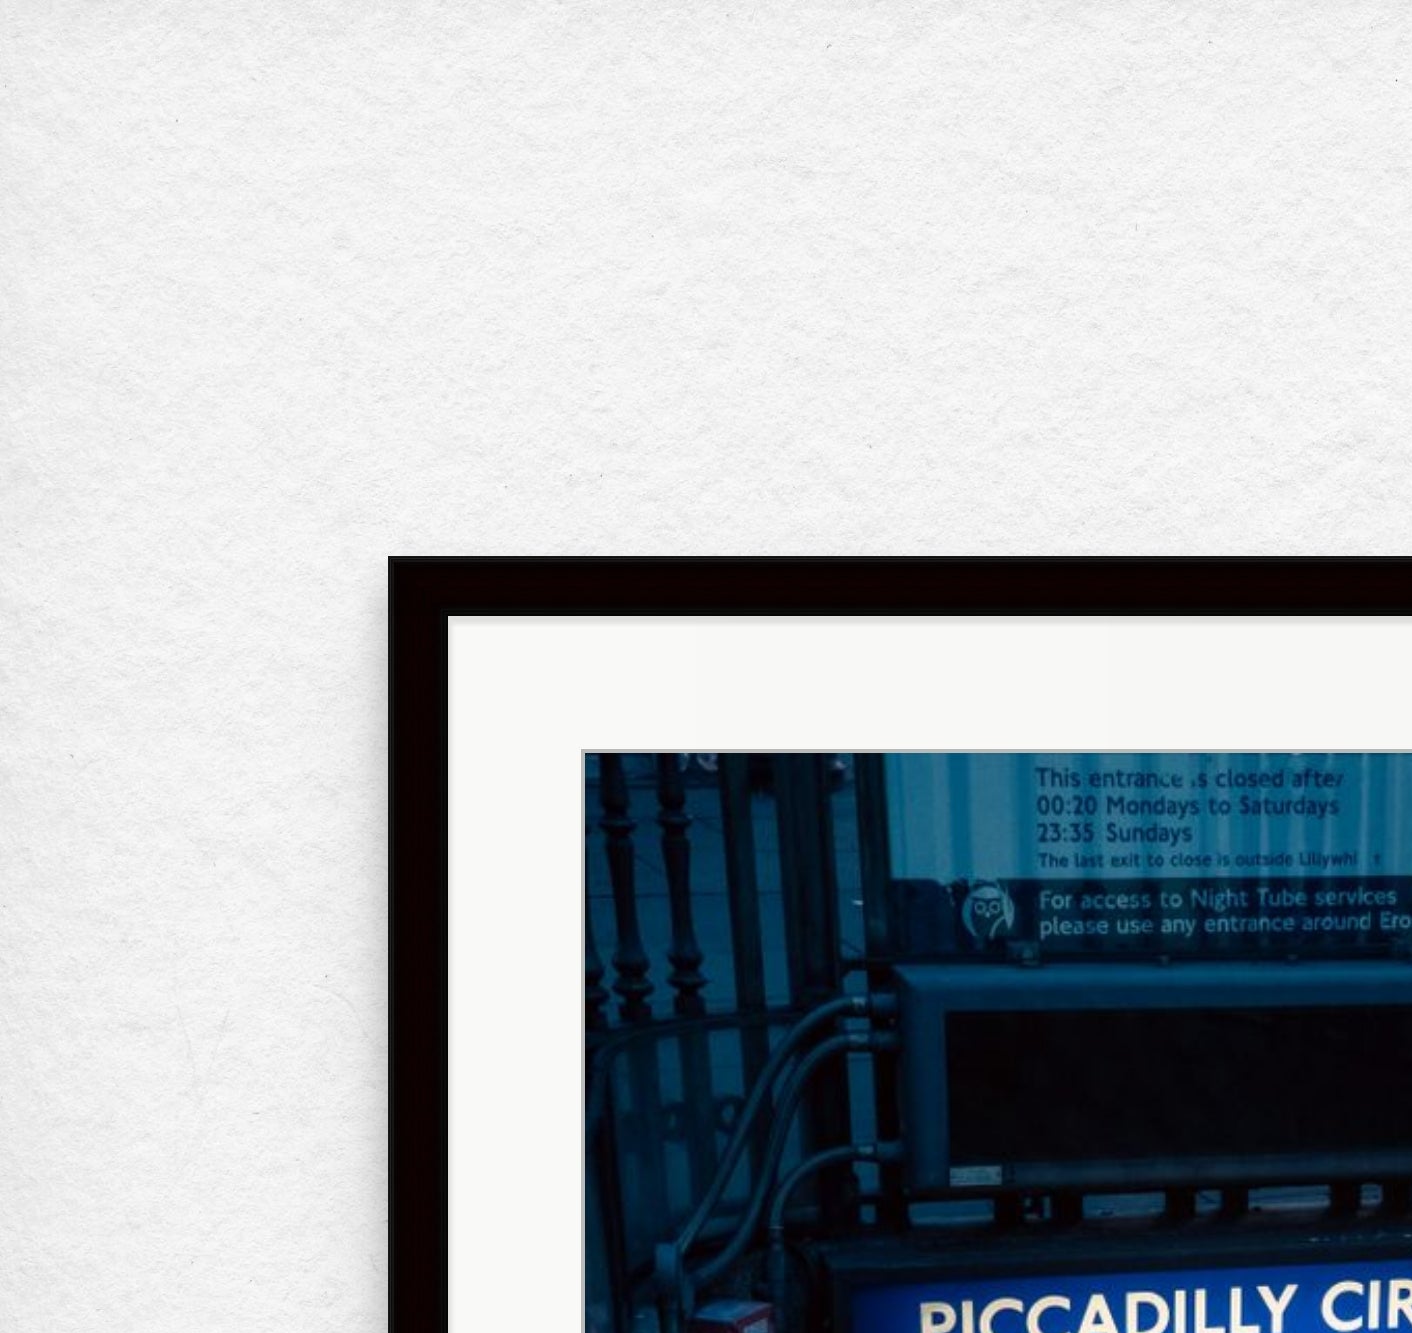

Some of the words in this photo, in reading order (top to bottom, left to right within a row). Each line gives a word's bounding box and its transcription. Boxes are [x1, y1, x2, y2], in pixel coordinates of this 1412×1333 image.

[1035, 767, 1081, 788] This
[1089, 769, 1183, 788] entrance
[1215, 768, 1284, 788] closed
[1292, 768, 1344, 788] after
[1037, 795, 1098, 816] 00:20
[1106, 796, 1200, 820] Mondays
[1208, 796, 1231, 816] to
[1239, 795, 1341, 820] Saturdays
[1037, 823, 1095, 844] 23:35
[1106, 823, 1193, 848] Sundays
[1038, 852, 1069, 869] The
[1075, 852, 1104, 869] last
[1111, 852, 1140, 868] exit
[1147, 852, 1165, 868] to
[1170, 851, 1213, 868] close
[1216, 851, 1231, 868] is
[1235, 851, 1294, 867] outside
[1039, 890, 1073, 910] For
[1081, 892, 1152, 910] access
[1160, 891, 1184, 909] to
[1190, 888, 1249, 913] Night
[1257, 887, 1307, 907] Tube
[1314, 887, 1398, 906] services
[1039, 916, 1109, 940] please
[1116, 918, 1154, 935] use
[1160, 918, 1197, 939] any
[1204, 914, 1296, 933] entrance
[1302, 911, 1372, 931] around
